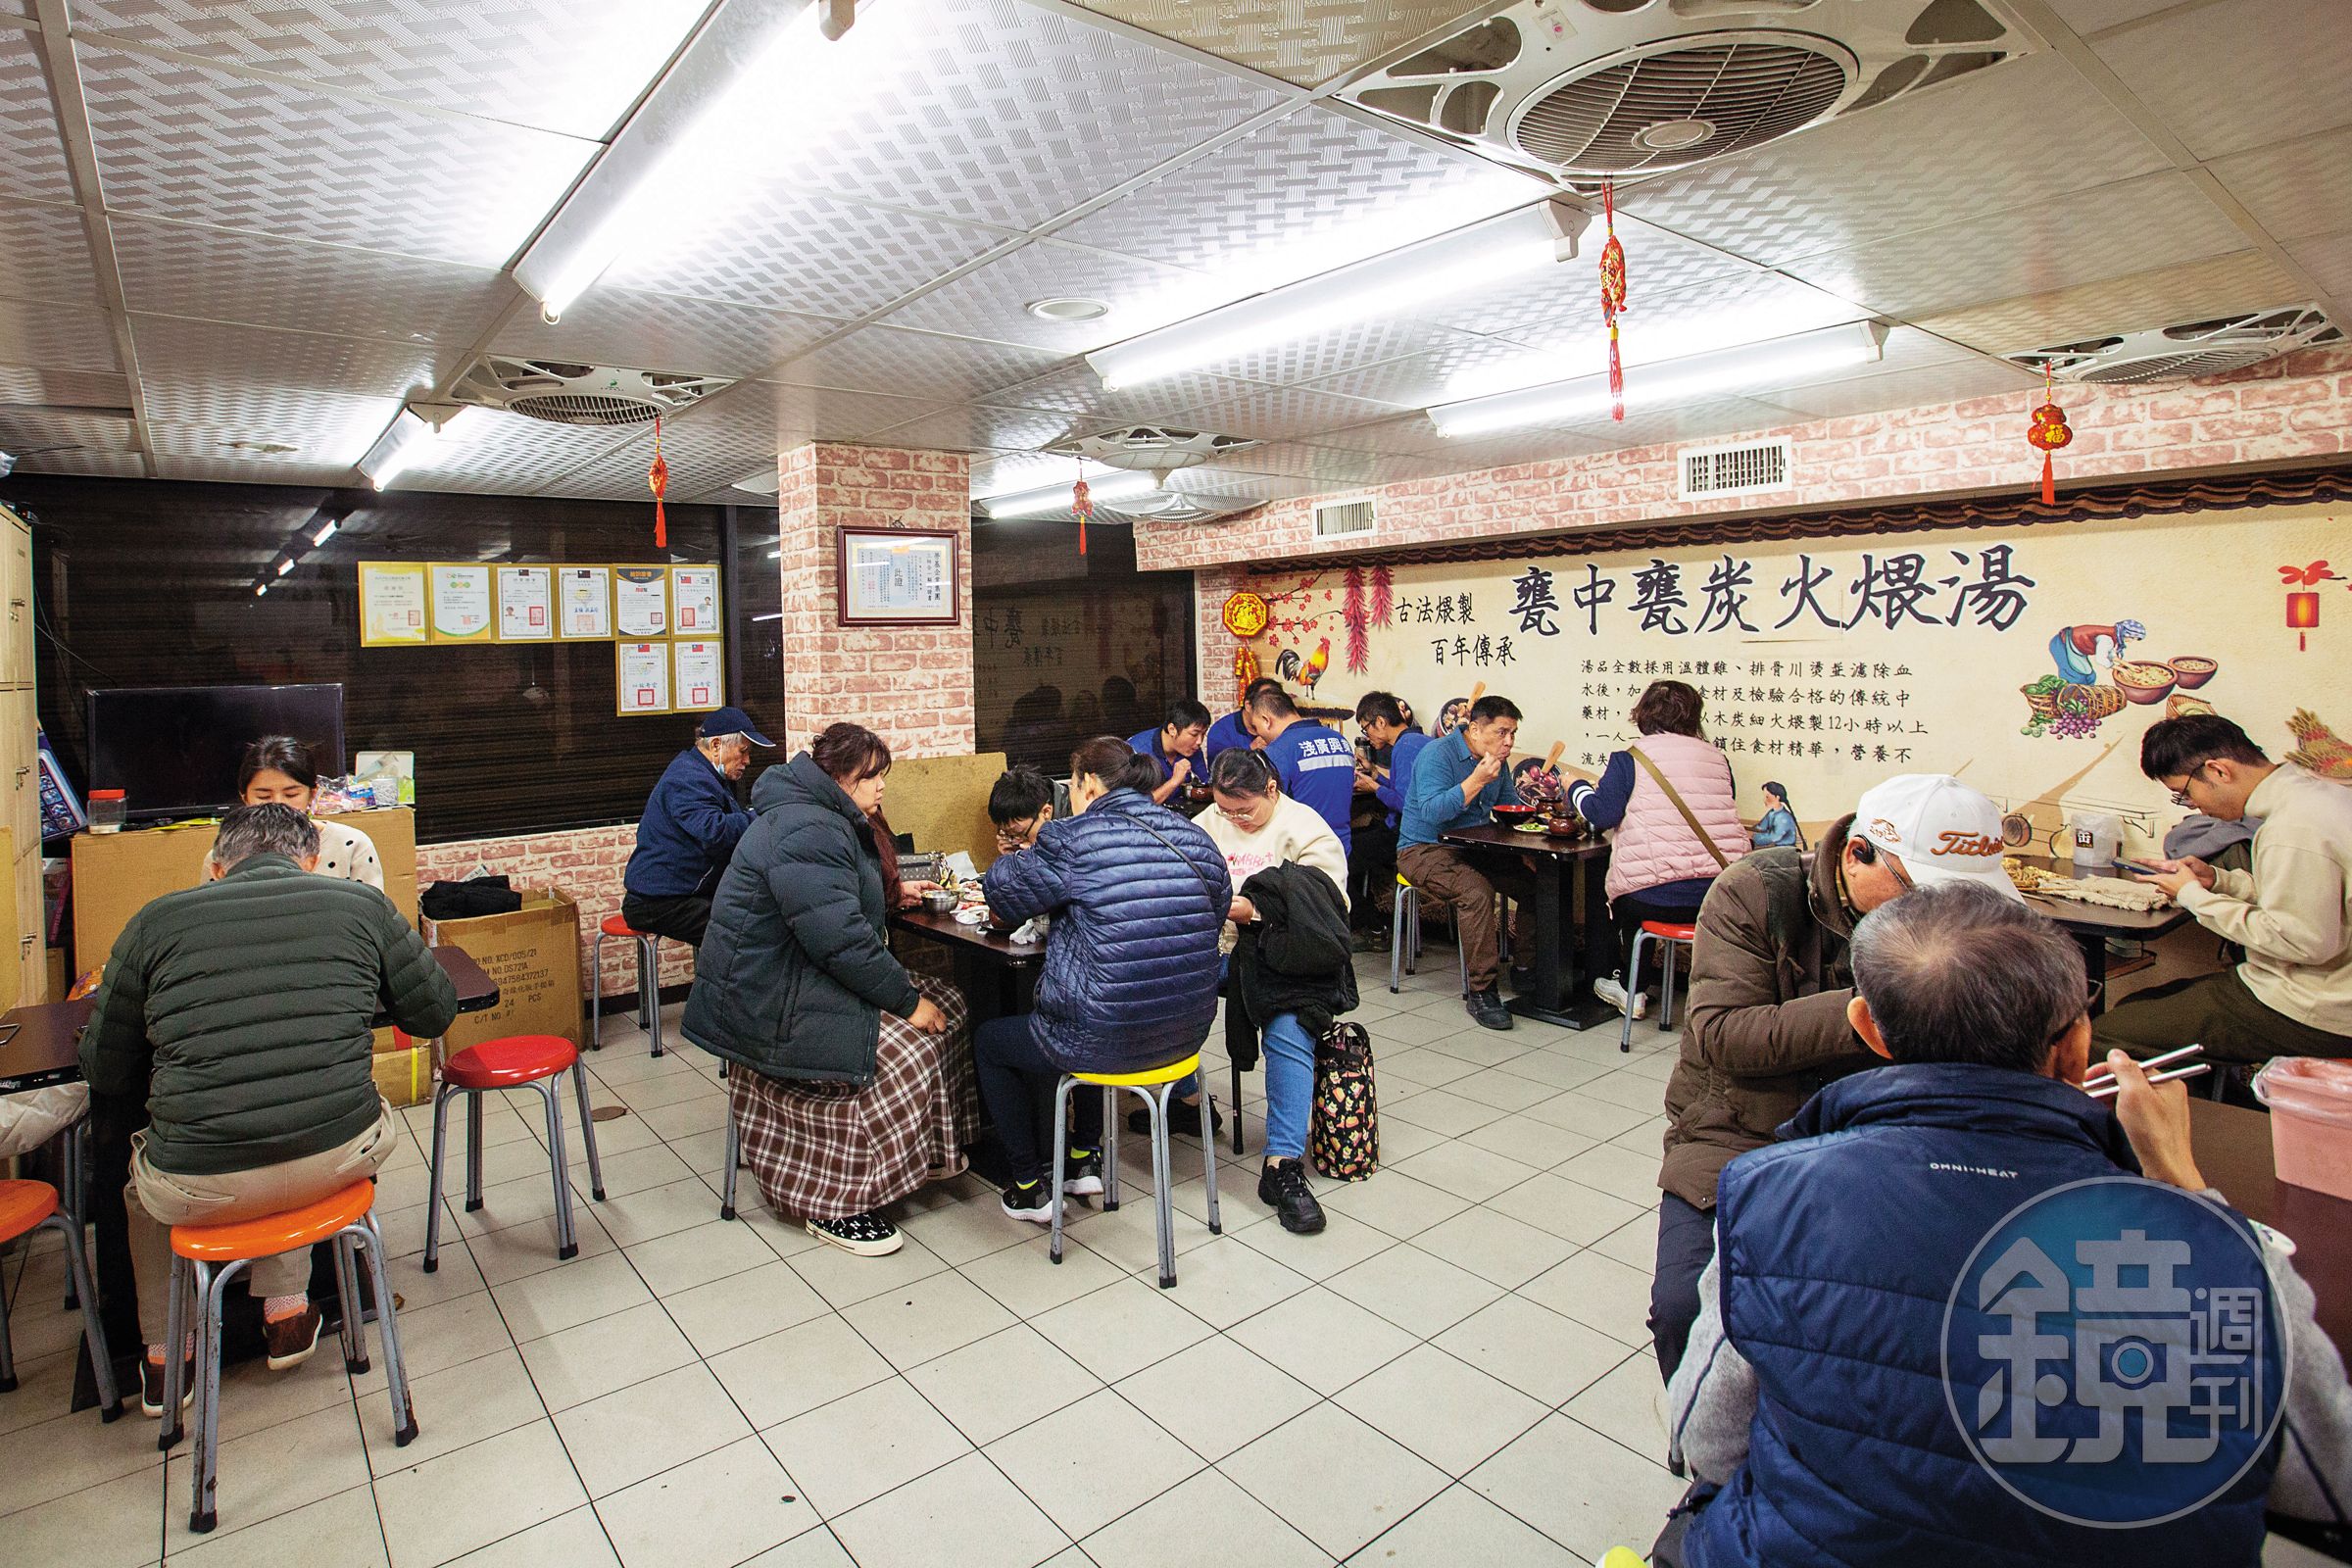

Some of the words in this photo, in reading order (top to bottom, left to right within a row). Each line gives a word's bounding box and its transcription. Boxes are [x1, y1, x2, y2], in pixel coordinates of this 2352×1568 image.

[1508, 544, 2036, 636] 甕中甕炭火煨湯
[1396, 592, 1476, 625] 古法煨製
[1431, 633, 1517, 667] 百年傳承
[528, 993, 542, 1004] PCS
